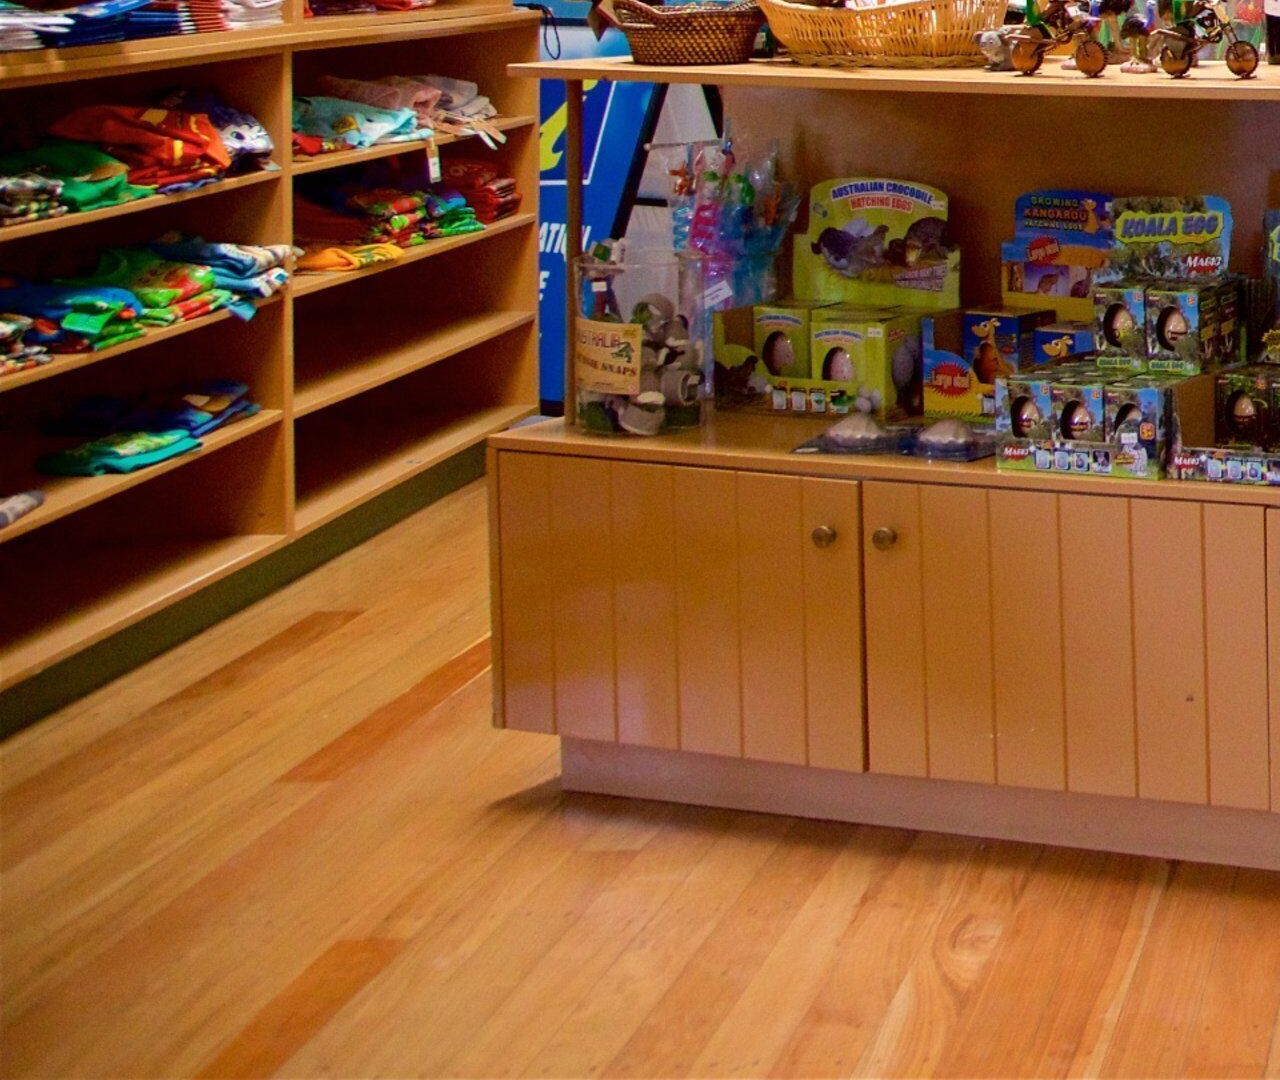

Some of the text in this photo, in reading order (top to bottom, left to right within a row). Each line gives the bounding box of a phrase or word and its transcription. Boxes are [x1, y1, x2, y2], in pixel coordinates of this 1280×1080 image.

[831, 181, 933, 205] AUSTRALIAN CROCODILE
[850, 196, 913, 211] HATCHING EGGS
[1030, 195, 1080, 208] GROWING
[1023, 207, 1088, 222] KANGAROO
[1121, 215, 1219, 238] KOALA EGG
